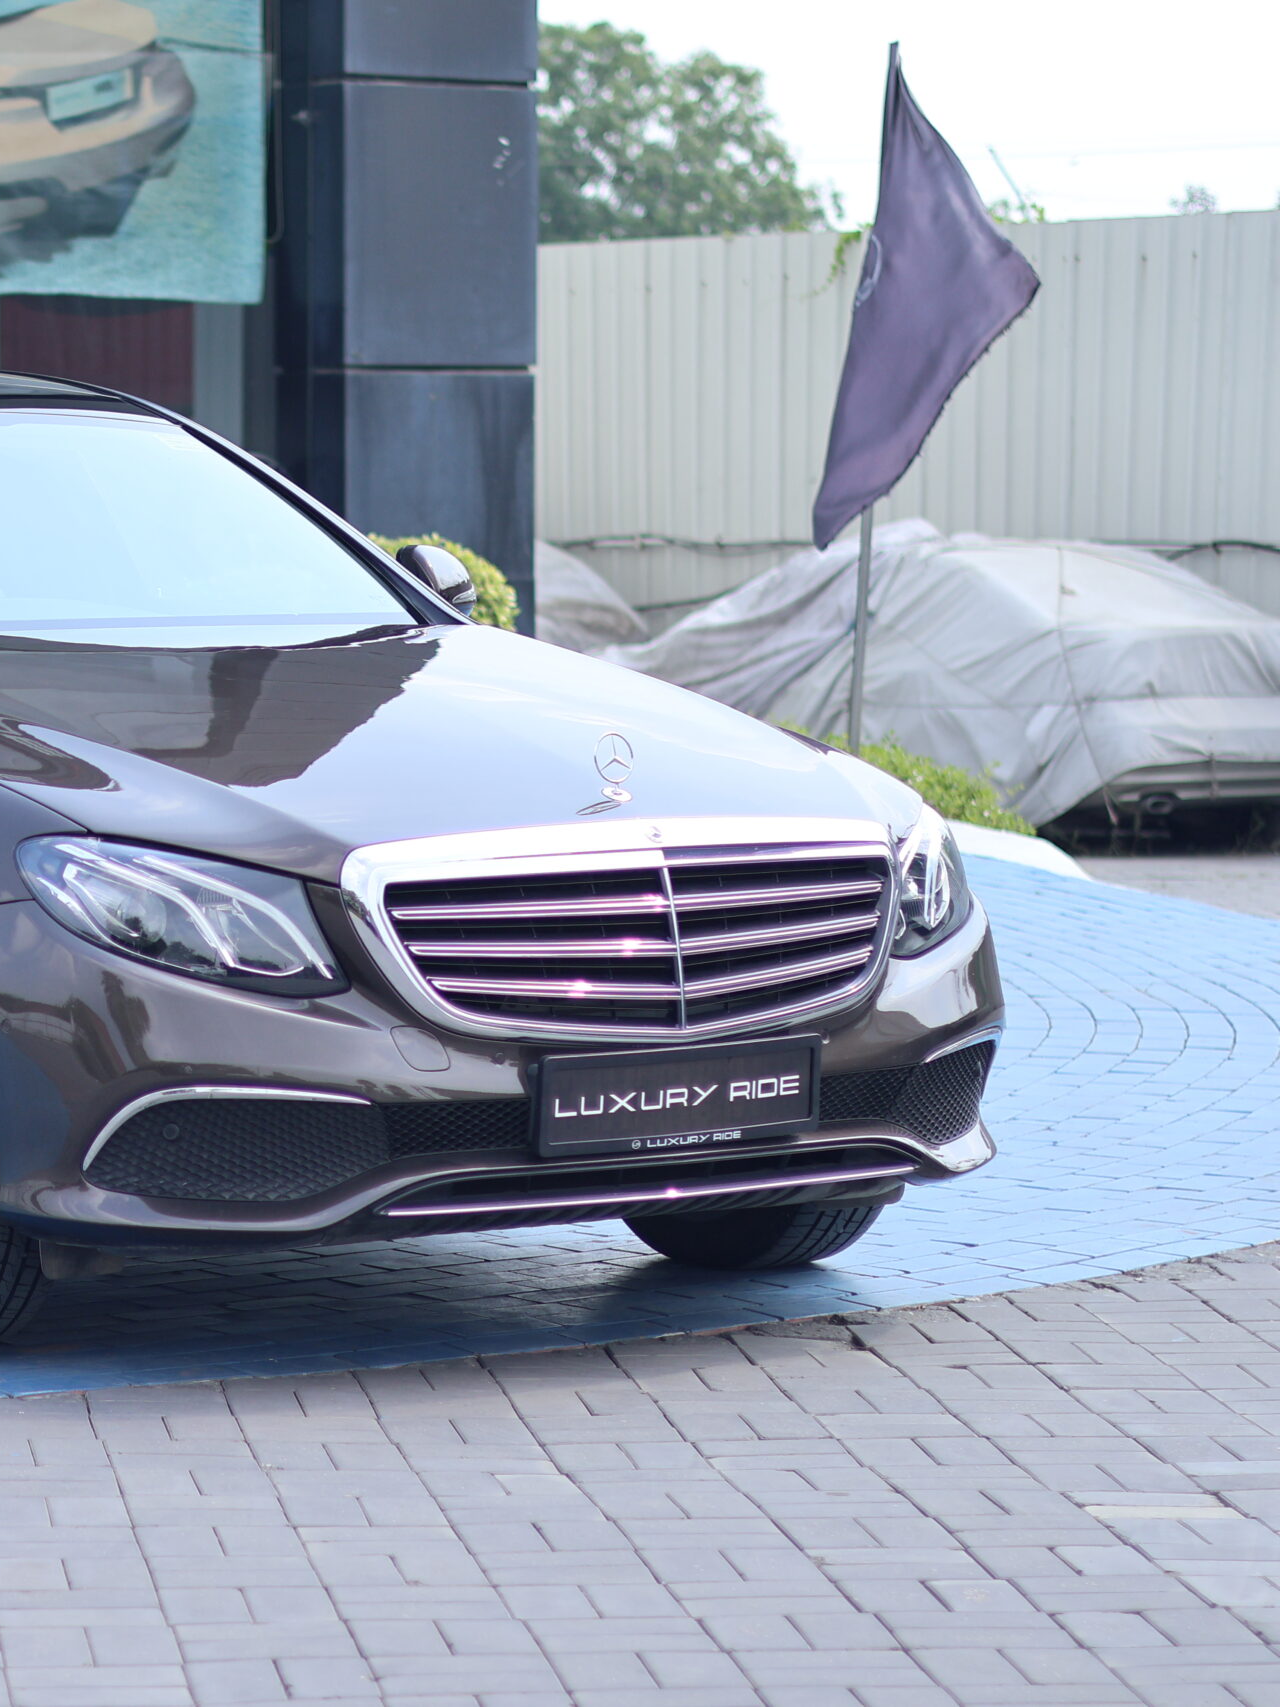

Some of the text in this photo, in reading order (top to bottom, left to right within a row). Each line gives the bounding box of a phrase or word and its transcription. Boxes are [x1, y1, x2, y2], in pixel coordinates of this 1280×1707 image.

[553, 1074, 801, 1118] LUXURY RIDE
[646, 1130, 742, 1148] LUXURY RIDE
